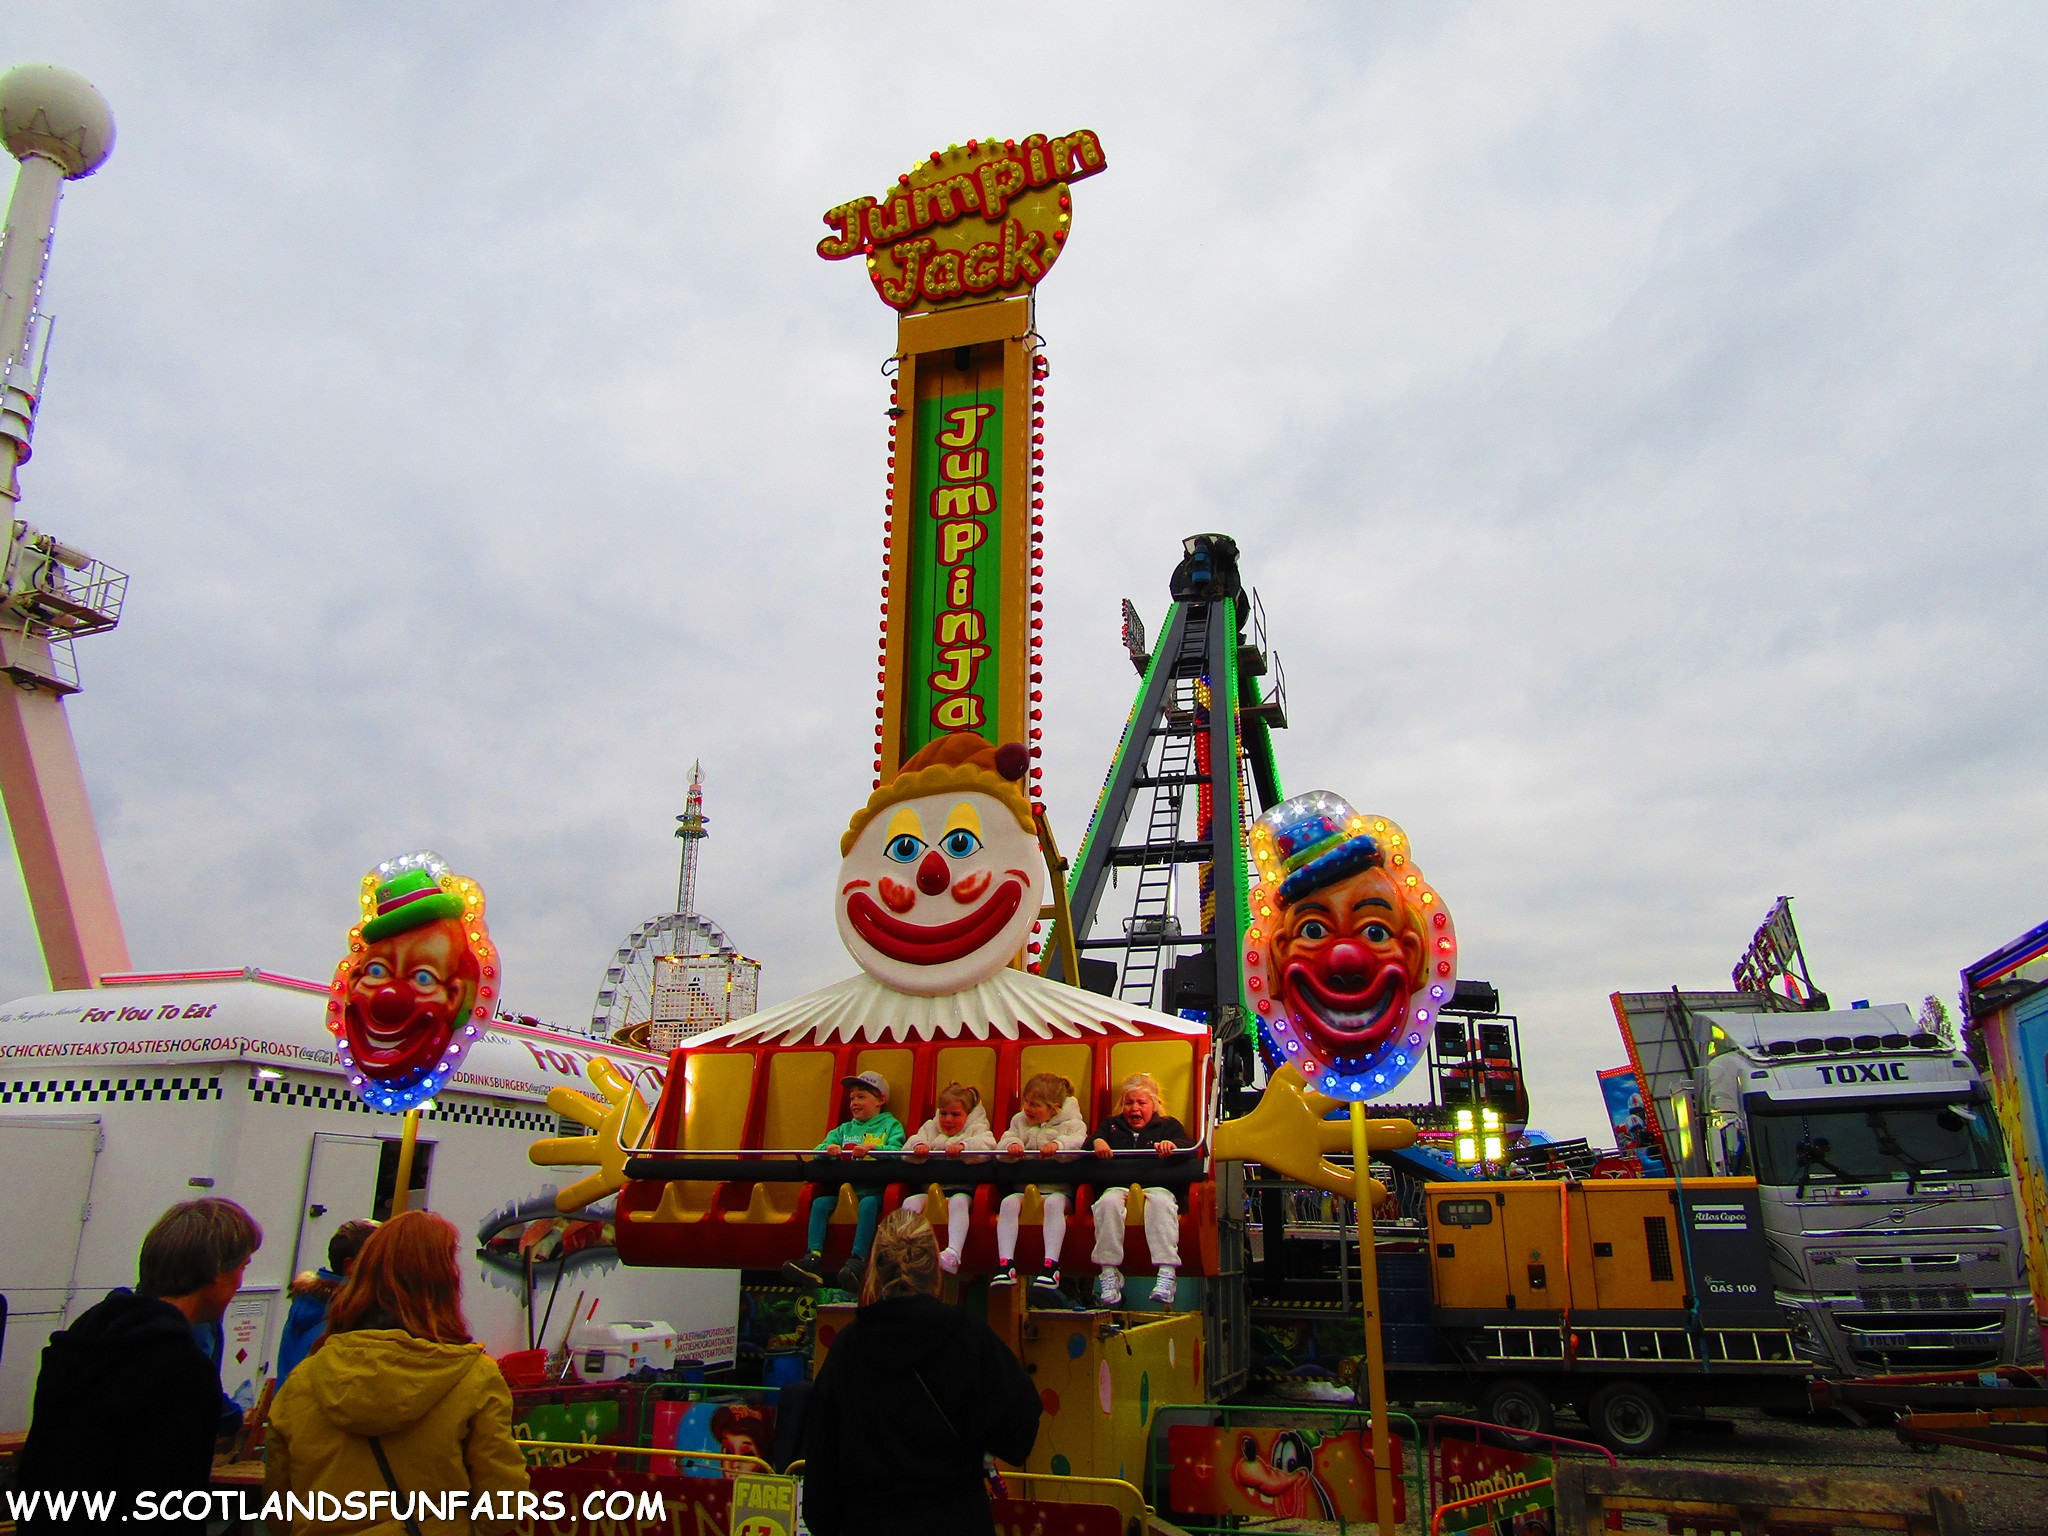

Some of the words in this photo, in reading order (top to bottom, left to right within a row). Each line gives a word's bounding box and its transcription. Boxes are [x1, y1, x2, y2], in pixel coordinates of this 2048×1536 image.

[817, 130, 1106, 258] Jumpin
[881, 217, 1044, 304] Jack
[80, 1008, 116, 1022] For
[117, 1006, 154, 1021] You
[156, 1004, 180, 1020] To
[181, 1003, 217, 1019] Eat
[519, 1040, 580, 1077] For
[1815, 1062, 1909, 1084] TOXIC
[1693, 1212, 1720, 1221] Atlas
[1720, 1212, 1747, 1222] Copco
[1709, 1284, 1734, 1293] QAS
[1736, 1283, 1757, 1293] 100
[736, 1482, 792, 1512] FARE
[1448, 1464, 1531, 1519] Jumpin
